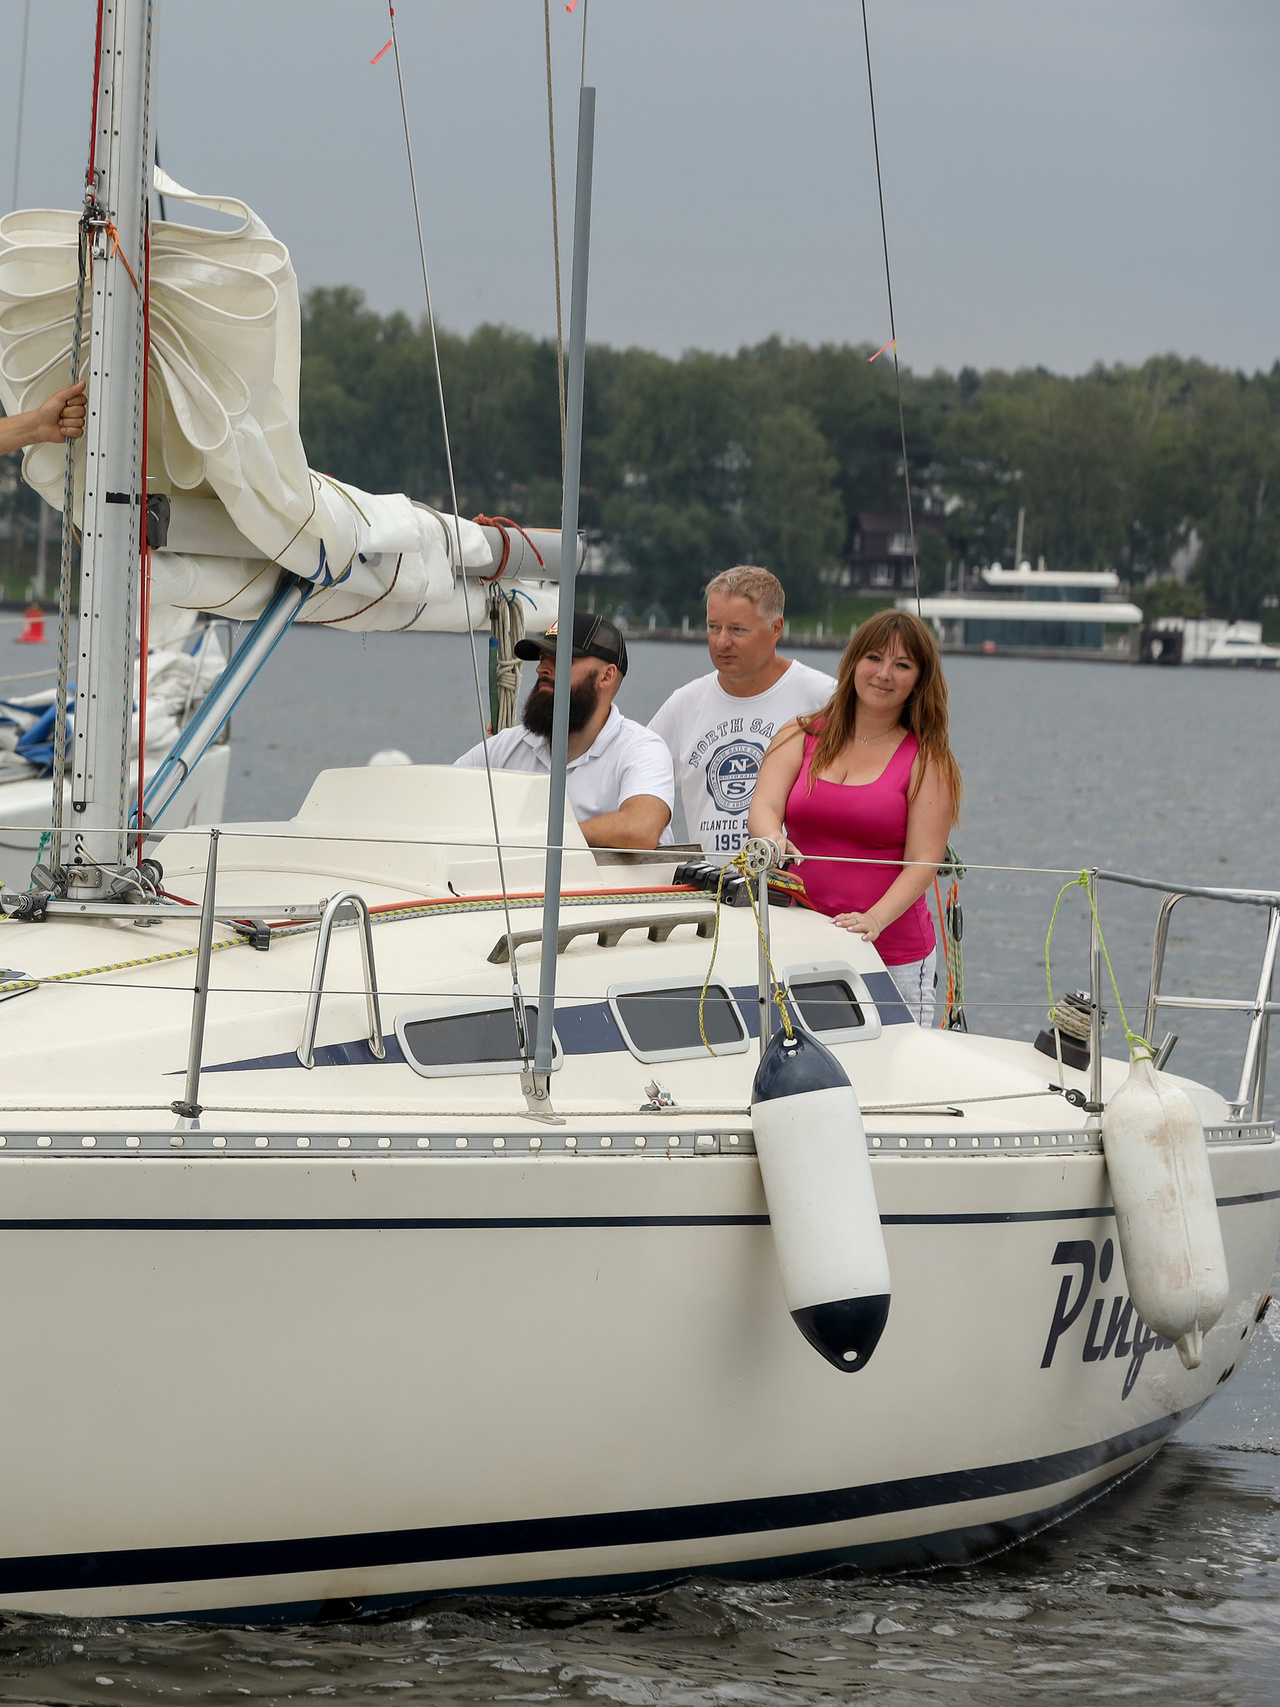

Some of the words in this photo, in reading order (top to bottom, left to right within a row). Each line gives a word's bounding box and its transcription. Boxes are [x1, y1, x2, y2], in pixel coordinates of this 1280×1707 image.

[689, 717, 744, 768] NORTH
[750, 718, 775, 740] SA
[700, 819, 739, 831] ATLANTIC
